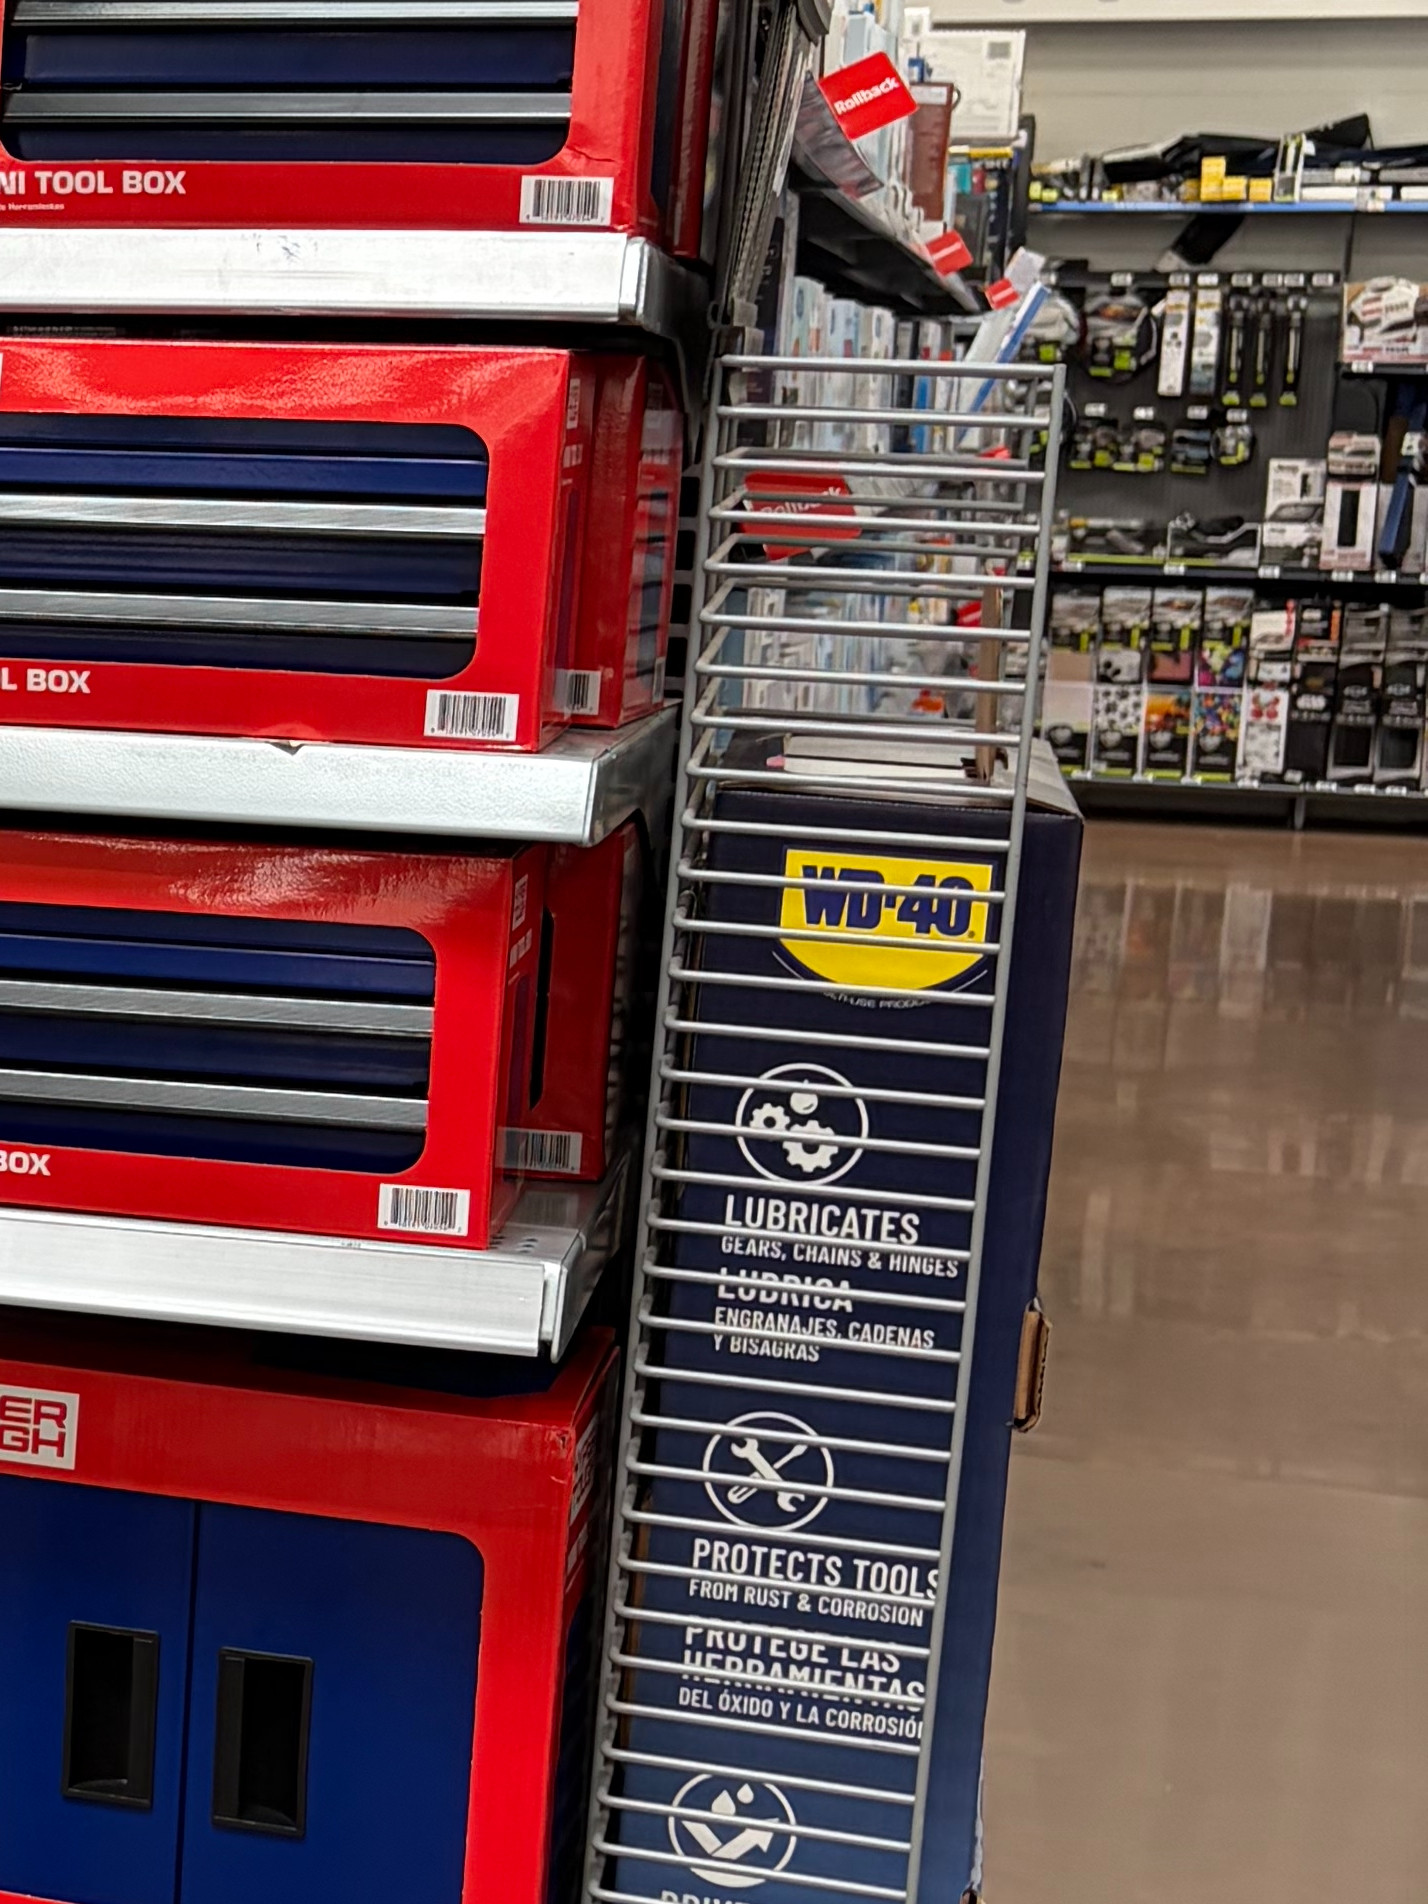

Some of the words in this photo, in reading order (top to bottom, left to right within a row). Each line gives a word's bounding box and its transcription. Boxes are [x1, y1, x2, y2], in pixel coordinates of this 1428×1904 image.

[833, 75, 900, 117] Rollback
[27, 669, 90, 693] BOX
[801, 863, 976, 938] WD-40
[724, 1194, 921, 1245] LUBRICATES
[720, 1235, 787, 1262] GEARS,
[793, 1242, 863, 1268] CHAINS
[867, 1251, 882, 1270] &
[889, 1253, 959, 1279] HINGES
[713, 1334, 723, 1352] Y
[729, 1334, 821, 1363] BISAGRAS
[714, 1306, 843, 1340] ENGRANAJES,
[848, 1320, 936, 1350] CADENAS
[692, 1537, 843, 1588] PROTECTS
[852, 1558, 940, 1600] TOOLS
[688, 1578, 738, 1603] FROM
[743, 1586, 793, 1610] RUST
[796, 1593, 812, 1613] &
[818, 1595, 924, 1628] CORROSION
[678, 1686, 714, 1710] DEL
[717, 1688, 774, 1718] ÓXIDO
[779, 1700, 792, 1720] Y
[796, 1703, 820, 1726] LA
